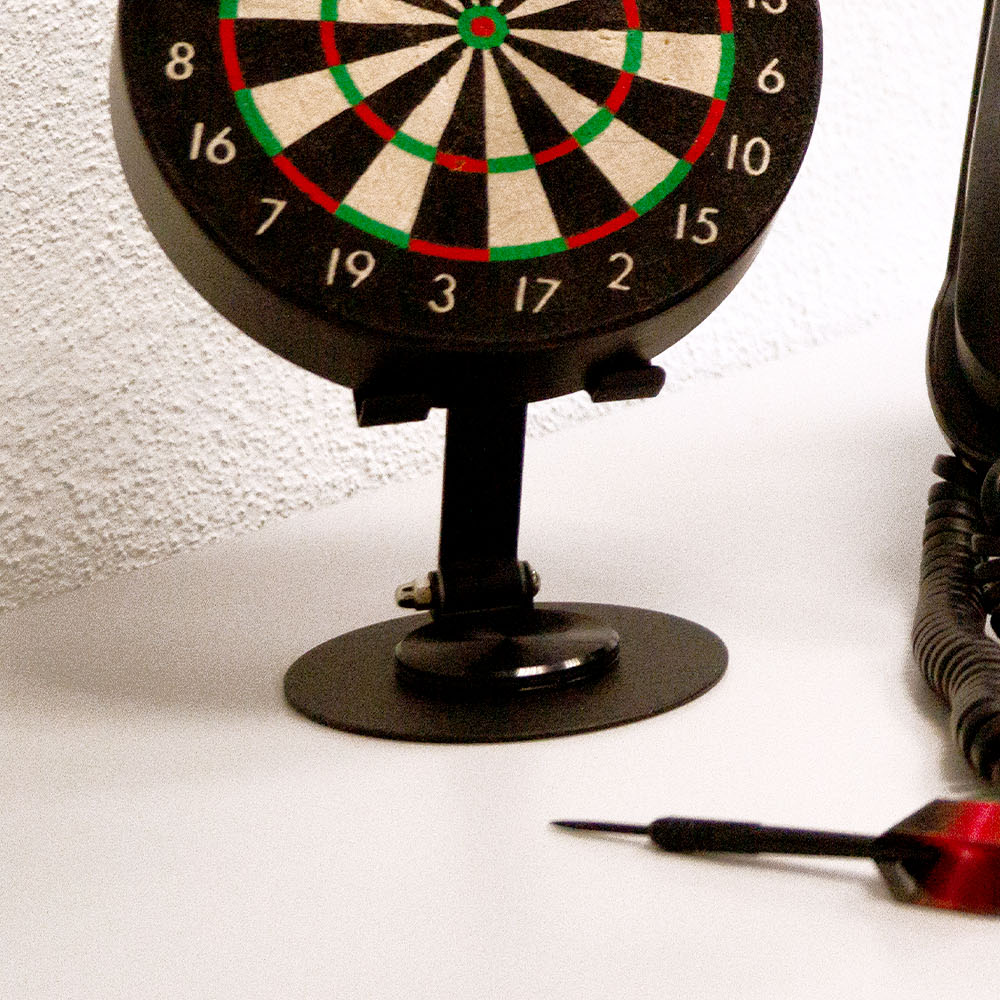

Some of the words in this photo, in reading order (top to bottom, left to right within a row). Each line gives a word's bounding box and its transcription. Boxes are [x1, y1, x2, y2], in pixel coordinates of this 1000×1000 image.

[167, 43, 194, 79] 8
[758, 59, 784, 93] 6
[191, 123, 235, 164] 16
[728, 135, 770, 175] 10
[257, 199, 286, 234] 7
[676, 204, 718, 244] 15
[328, 249, 375, 287] 19
[609, 253, 633, 290] 2
[429, 274, 456, 312] 3
[516, 277, 560, 312] 17
